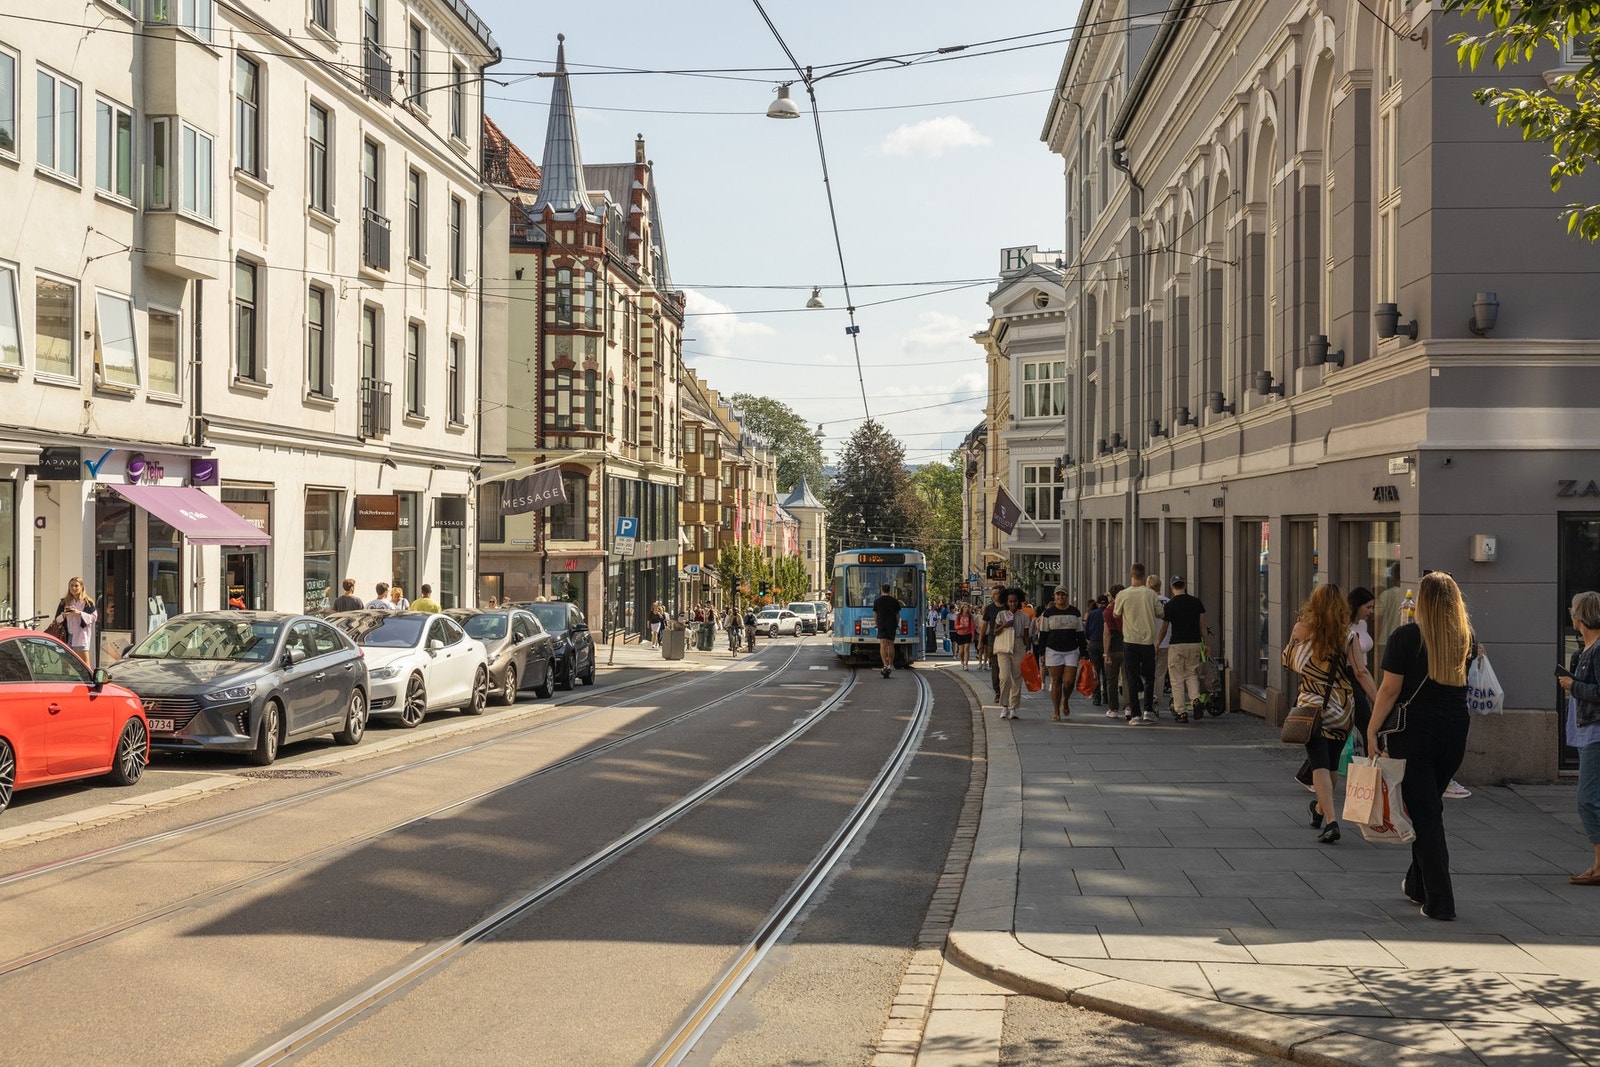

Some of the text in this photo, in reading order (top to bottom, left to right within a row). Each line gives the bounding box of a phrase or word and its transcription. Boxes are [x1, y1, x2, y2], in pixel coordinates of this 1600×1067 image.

[1006, 249, 1029, 270] HK
[502, 487, 559, 509] MESSAGE
[1466, 686, 1495, 699] REMA
